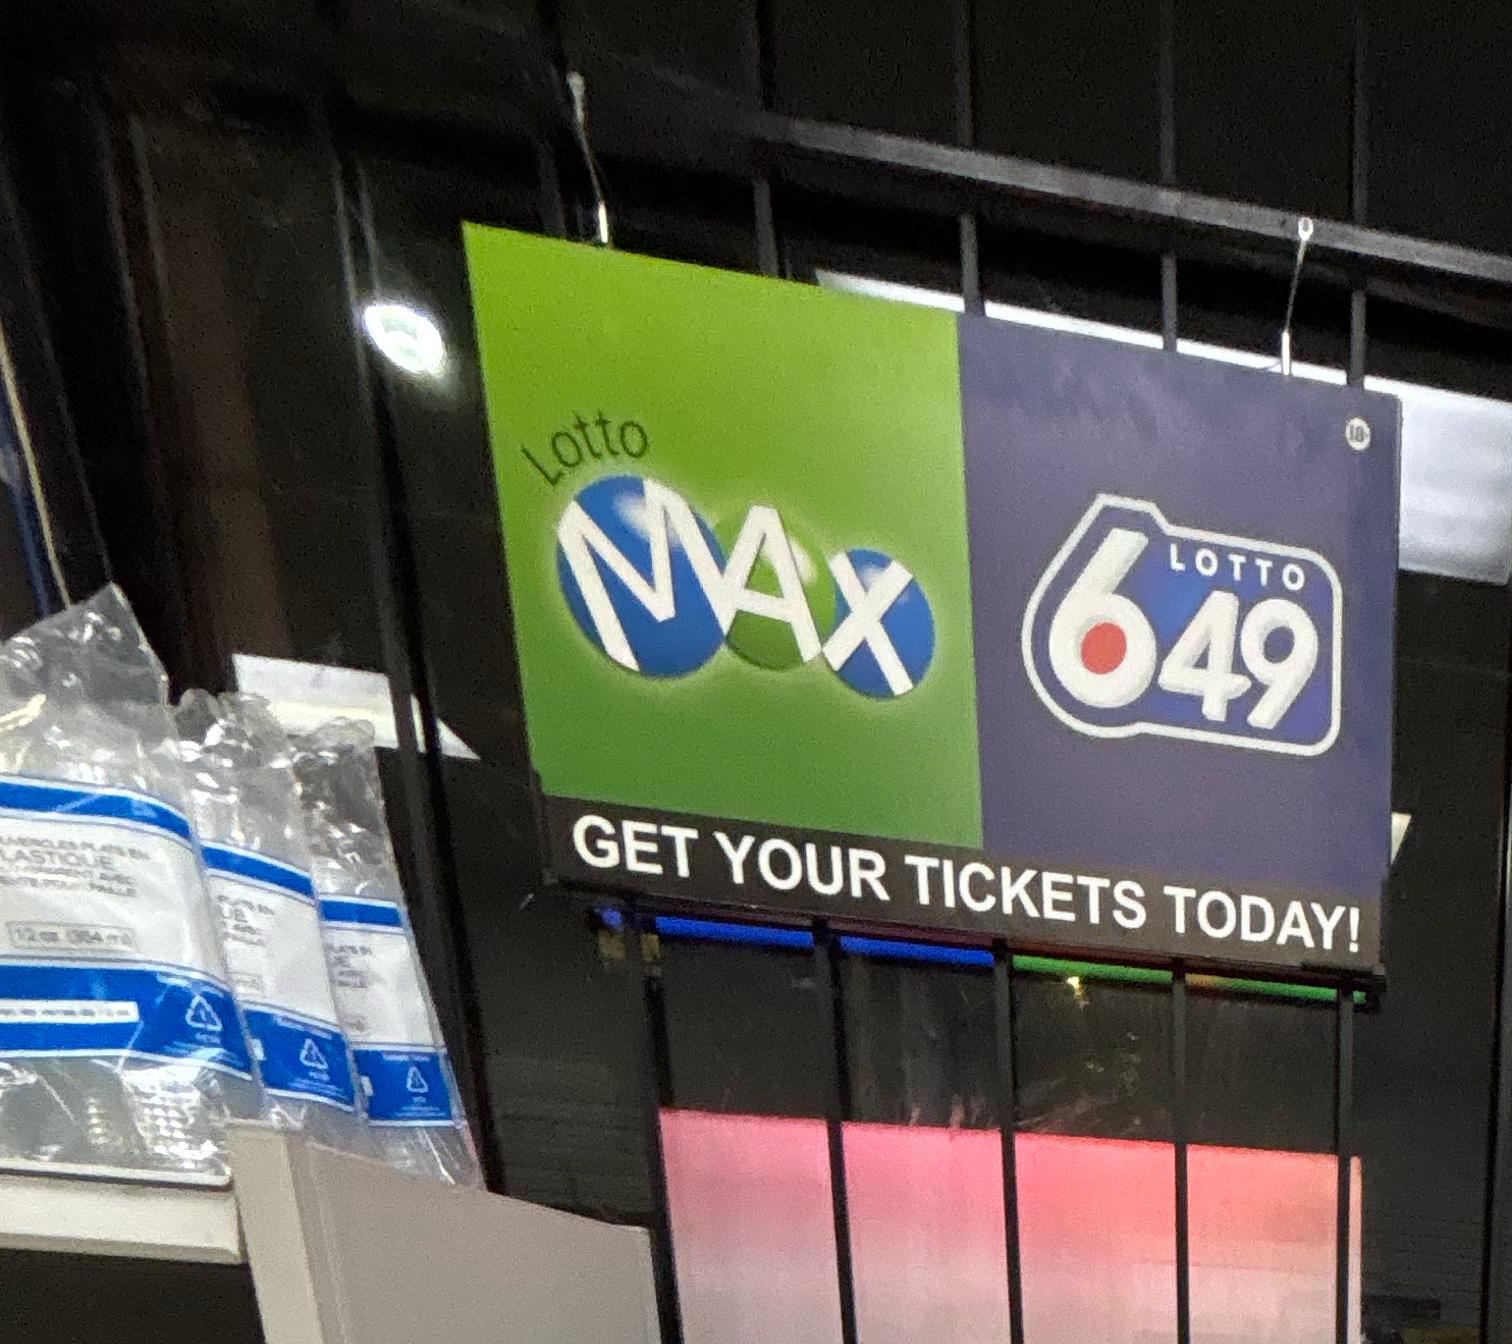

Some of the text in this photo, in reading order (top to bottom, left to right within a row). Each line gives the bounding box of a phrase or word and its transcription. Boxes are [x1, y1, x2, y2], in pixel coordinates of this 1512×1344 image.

[520, 412, 651, 488] Lotto
[557, 477, 915, 697] MAX
[1168, 541, 1307, 592] LOTTO
[573, 813, 1362, 954] GET YOUR TICKETS TODAY!
